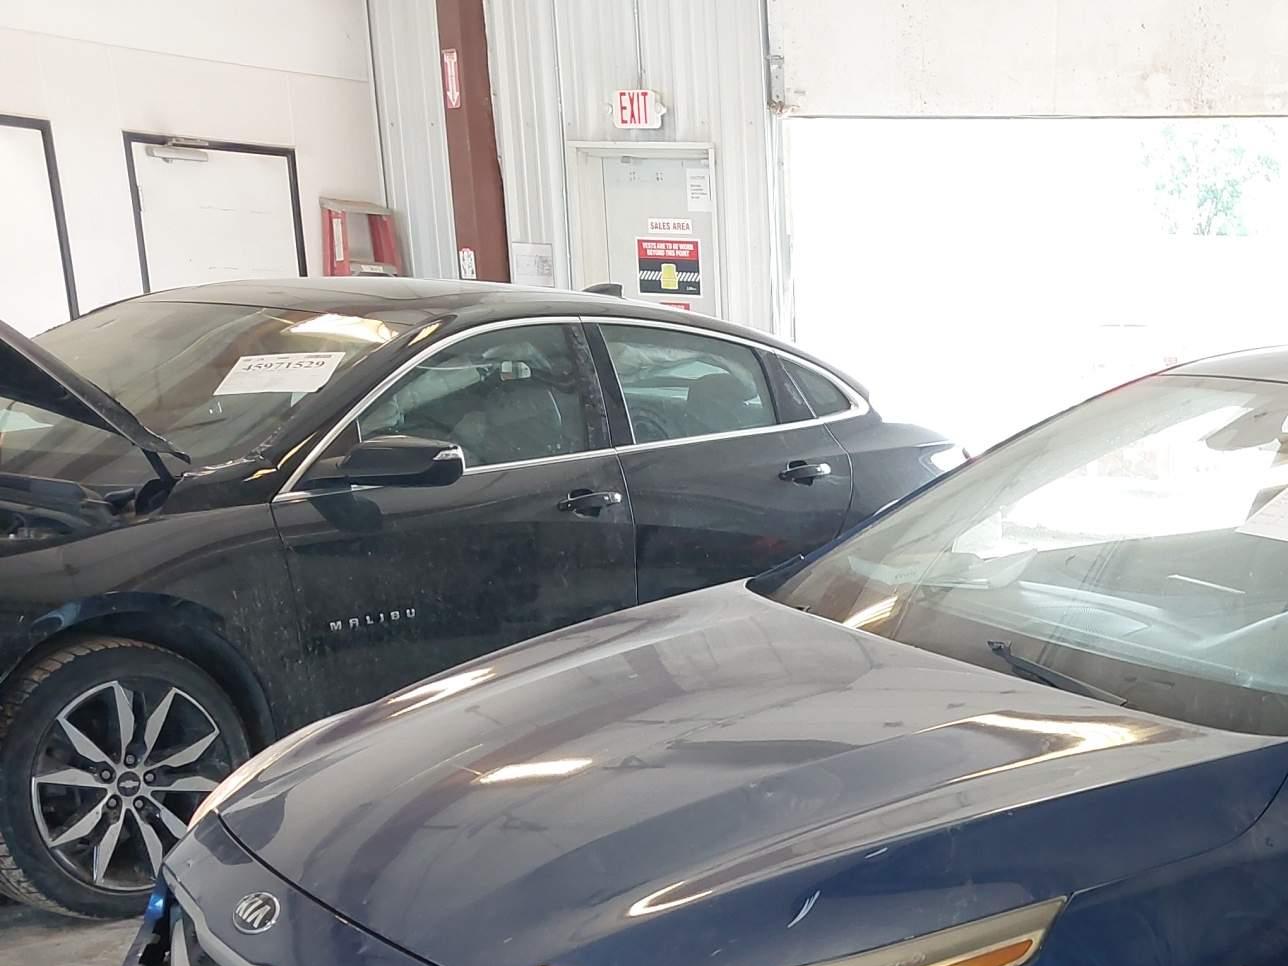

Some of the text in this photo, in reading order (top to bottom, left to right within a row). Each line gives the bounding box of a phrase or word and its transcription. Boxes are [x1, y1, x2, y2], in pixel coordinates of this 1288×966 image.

[619, 91, 648, 124] EXIT
[650, 221, 690, 231] SALES AREA
[242, 361, 325, 371] 45971529
[330, 608, 416, 631] MALIBU
[238, 897, 271, 929] KIA
